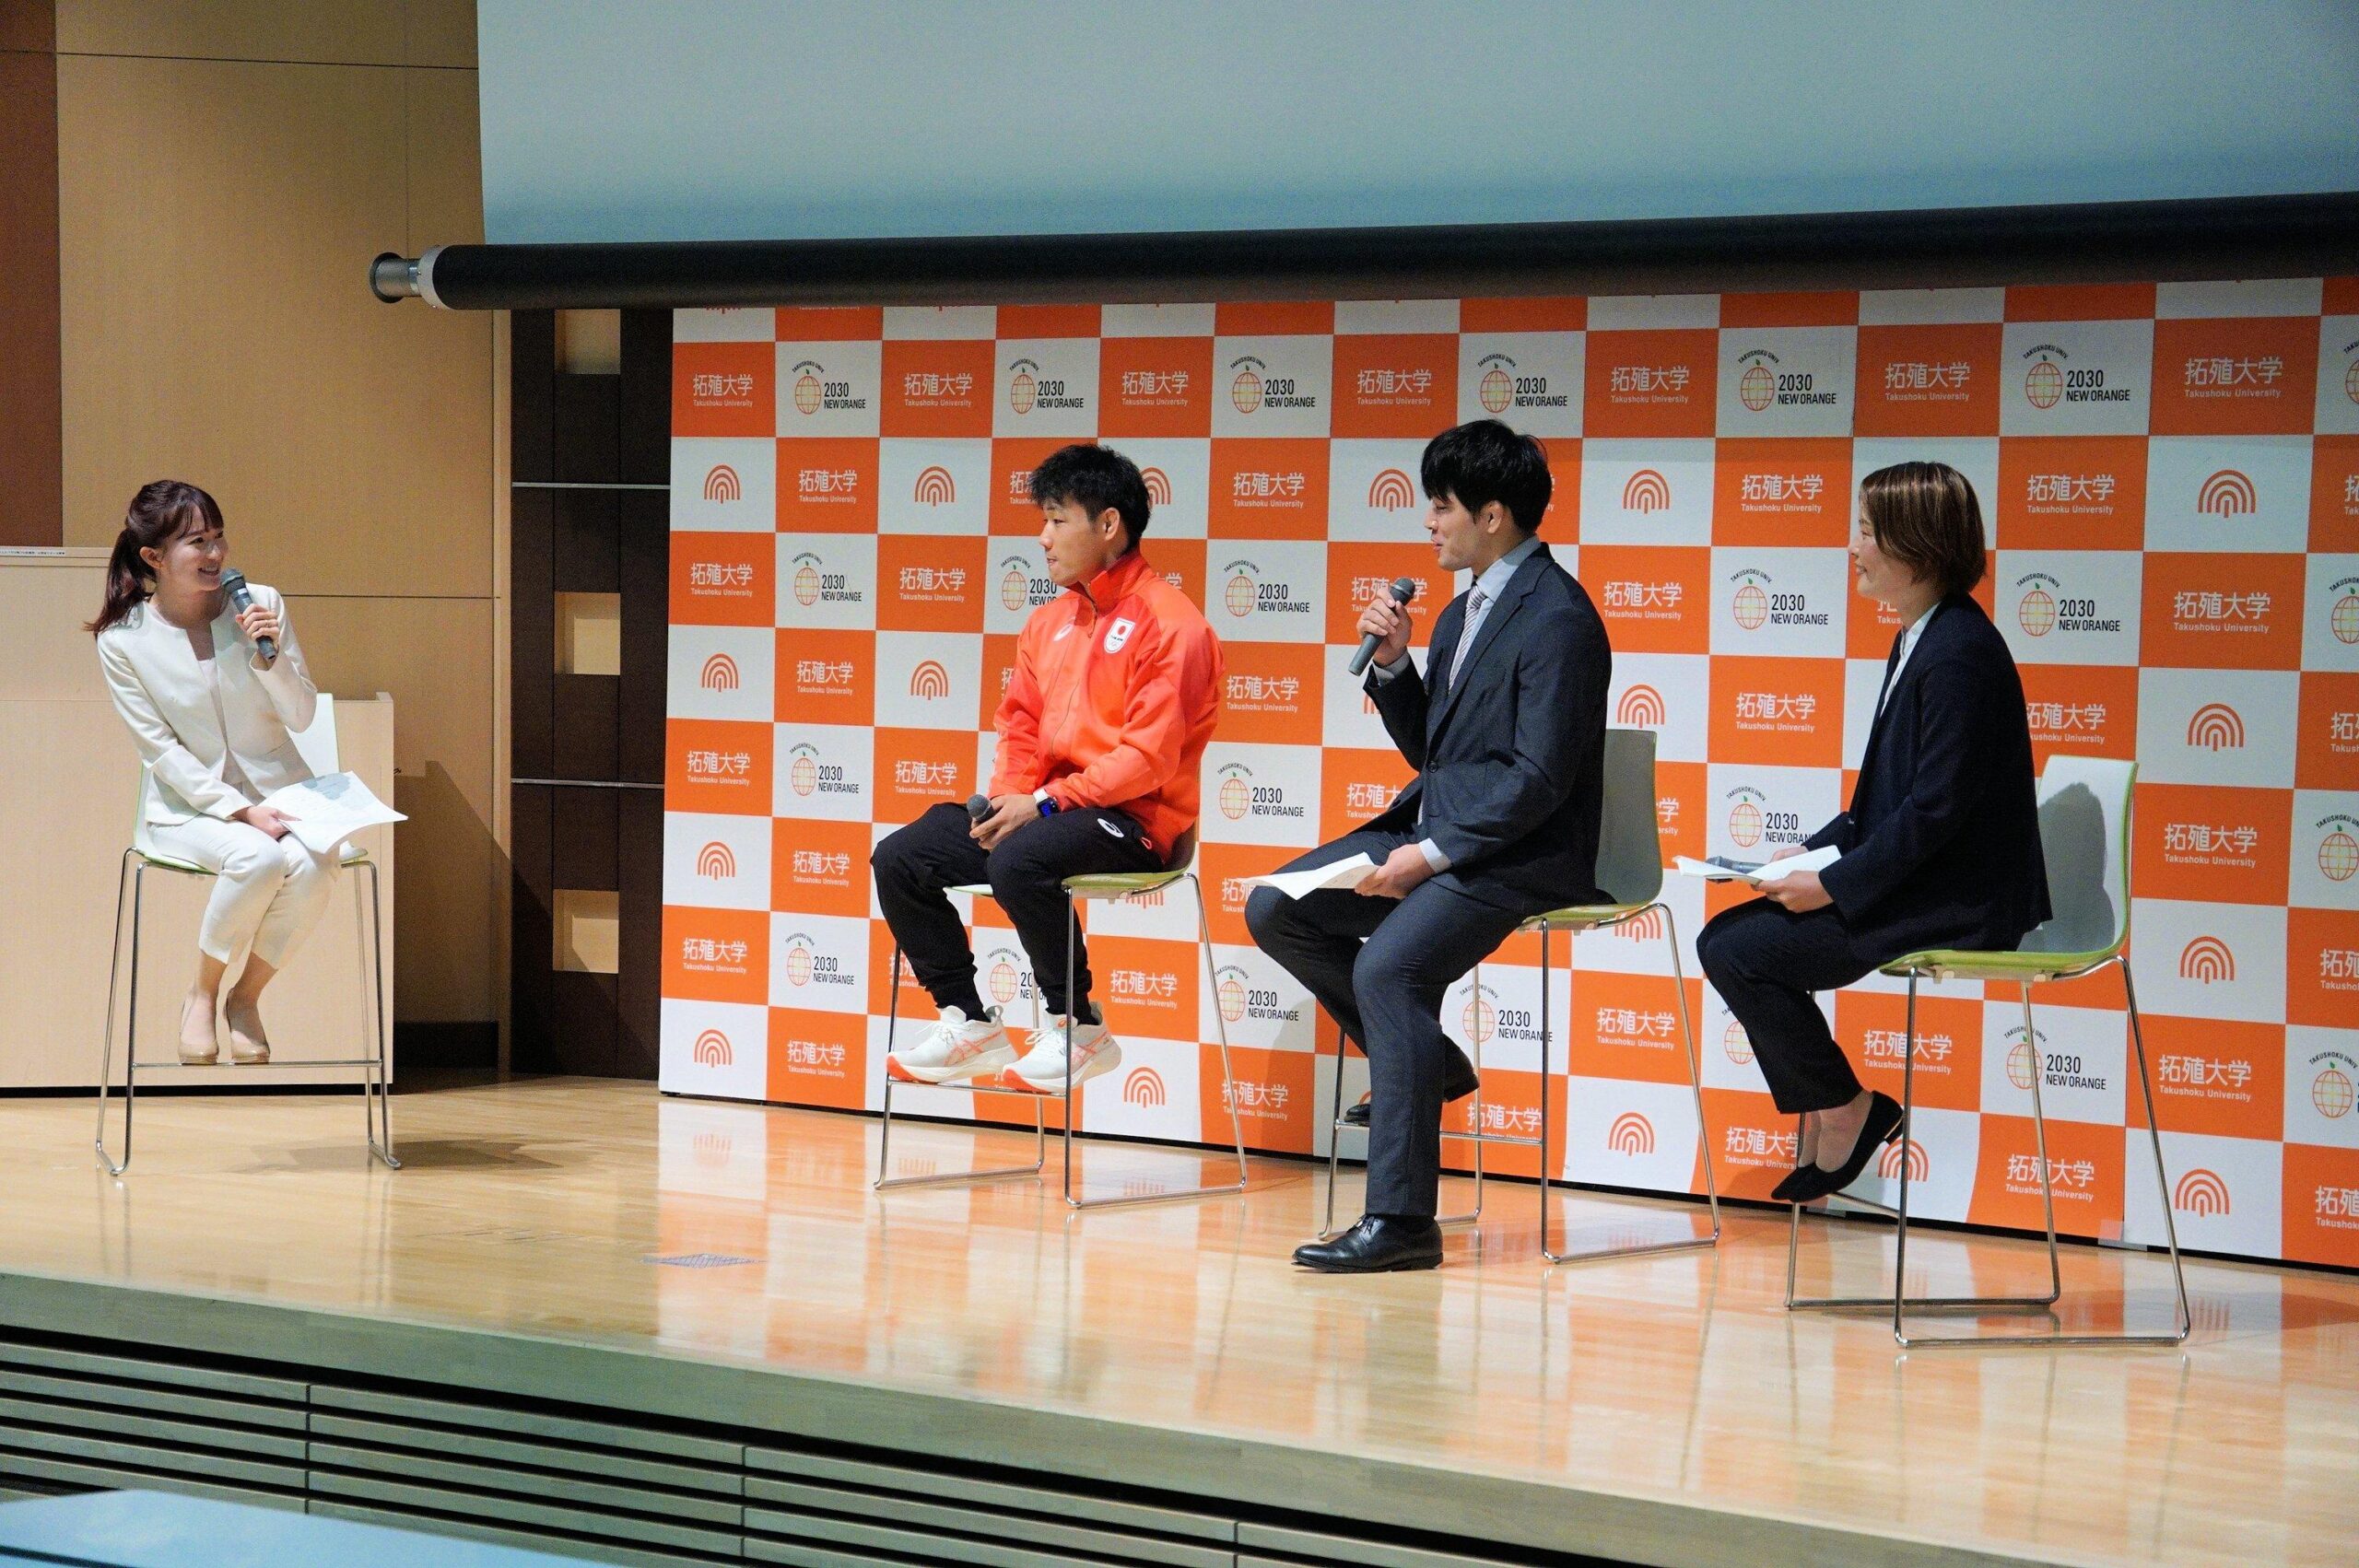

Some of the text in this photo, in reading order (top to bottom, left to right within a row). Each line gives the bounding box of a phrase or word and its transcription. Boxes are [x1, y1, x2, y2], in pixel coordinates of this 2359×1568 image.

[1610, 365, 1690, 392] 拓殖大学
[1884, 361, 1971, 390] 拓殖大学
[2066, 369, 2105, 389] 2030
[2184, 356, 2283, 386] 拓殖大学
[692, 373, 754, 397] 拓殖大学
[824, 381, 850, 398] 2030
[904, 372, 973, 397] 拓殖大学
[1037, 380, 1065, 397] 2030
[1121, 370, 1190, 395] 拓殖大学
[1264, 379, 1295, 396] 2030
[1356, 369, 1432, 394] 拓殖大学
[1515, 377, 1547, 394] 2030
[1778, 373, 1813, 392] 2030
[1357, 396, 1431, 406] Takushoku University
[1515, 395, 1568, 407] NEW ORANGE
[1611, 394, 1688, 404] Takushoku University
[1778, 392, 1837, 405] NEW ORANGE
[1884, 392, 1970, 402] Takushoku University
[2066, 389, 2130, 403] NEW ORANGE
[2185, 388, 2282, 399] Takushoku University
[693, 399, 753, 407] Takushoku University
[823, 398, 866, 410] NEW ORANGE
[904, 398, 971, 407] Takushoku University
[1037, 397, 1085, 409] NEW ORANGE
[1121, 397, 1189, 407] Takushoku University
[1264, 396, 1316, 408] NEW ORANGE
[798, 469, 858, 493] 拓殖大学
[1233, 472, 1306, 497] 拓殖大学
[1741, 474, 1824, 501] 拓殖大学
[2026, 474, 2116, 502] 拓殖大学
[799, 495, 857, 504] Takushoku University
[1233, 498, 1304, 509] Takushoku University
[1741, 503, 1822, 514] Takushoku University
[2026, 504, 2114, 515] Takushoku University
[690, 562, 754, 587] 拓殖大学
[821, 574, 845, 591] 2030
[899, 567, 967, 591] 拓殖大学
[691, 587, 753, 598] Takushoku University
[1029, 579, 1057, 594] 2030
[1258, 583, 1289, 601] 2030
[1603, 580, 1683, 608] 拓殖大学
[821, 591, 863, 603] NEW ORANGE
[898, 592, 965, 603] Takushoku University
[1028, 596, 1047, 606] NEW
[1771, 593, 1805, 612] 2030
[1257, 601, 1310, 614] NEW ORANGE
[2059, 599, 2095, 618] 2030
[2173, 591, 2271, 620] 拓殖大学
[1604, 609, 1682, 620] Takushoku University
[1770, 613, 1829, 626] NEW ORANGE
[2059, 619, 2121, 632] NEW ORANGE
[2173, 622, 2270, 634] Takushoku University
[796, 660, 854, 685] 拓殖大学
[797, 685, 853, 696] Takushoku University
[1226, 674, 1299, 701] 拓殖大学
[1226, 701, 1298, 713] Takushoku University
[1735, 692, 1816, 720] 拓殖大学
[1736, 720, 1814, 732] Takushoku University
[2064, 733, 2106, 745] University
[687, 750, 751, 775] 拓殖大学
[687, 775, 750, 787] Takushoku University
[818, 765, 843, 781] 2030
[895, 760, 957, 786] 拓殖大学
[817, 781, 860, 794] NEW ORANGE
[895, 785, 957, 798] Takushoku University
[1251, 786, 1283, 804] 2030
[1251, 804, 1304, 817] NEW ORANGE
[1766, 812, 1799, 831] 2030
[1766, 832, 1787, 844] NEW
[2164, 823, 2258, 854] 拓殖大学
[792, 849, 851, 876] 拓殖大学
[2165, 853, 2256, 869] Takushoku University
[792, 875, 850, 887] Takushoku University
[682, 937, 748, 963] 拓殖大学
[683, 962, 747, 974] Takushoku University
[813, 955, 839, 973] 2030
[813, 972, 855, 986] NEW ORANGE
[1109, 969, 1178, 998] 拓殖大学
[1110, 995, 1178, 1009] Takushoku University
[1248, 989, 1278, 1008] 2030
[1248, 1007, 1300, 1022] NEW ORANGE
[1498, 1010, 1532, 1028] 2030
[1596, 1007, 1676, 1037] 拓殖大学
[1498, 1028, 1554, 1043] NEW ORANE
[1597, 1035, 1674, 1050] Takushoku University
[786, 1039, 846, 1067] 拓殖大学
[1863, 1029, 1953, 1061] 拓殖大学
[788, 1065, 845, 1078] Takushoku University
[2046, 1053, 2082, 1074] 2030
[2158, 1054, 2252, 1088] 拓殖大学
[2046, 1073, 2107, 1091] NEW ORANGE
[2159, 1084, 2251, 1103] Takushoku University
[1256, 1109, 1288, 1121] University
[1724, 1155, 1764, 1166] Takushoku
[2050, 1188, 2094, 1202] University
